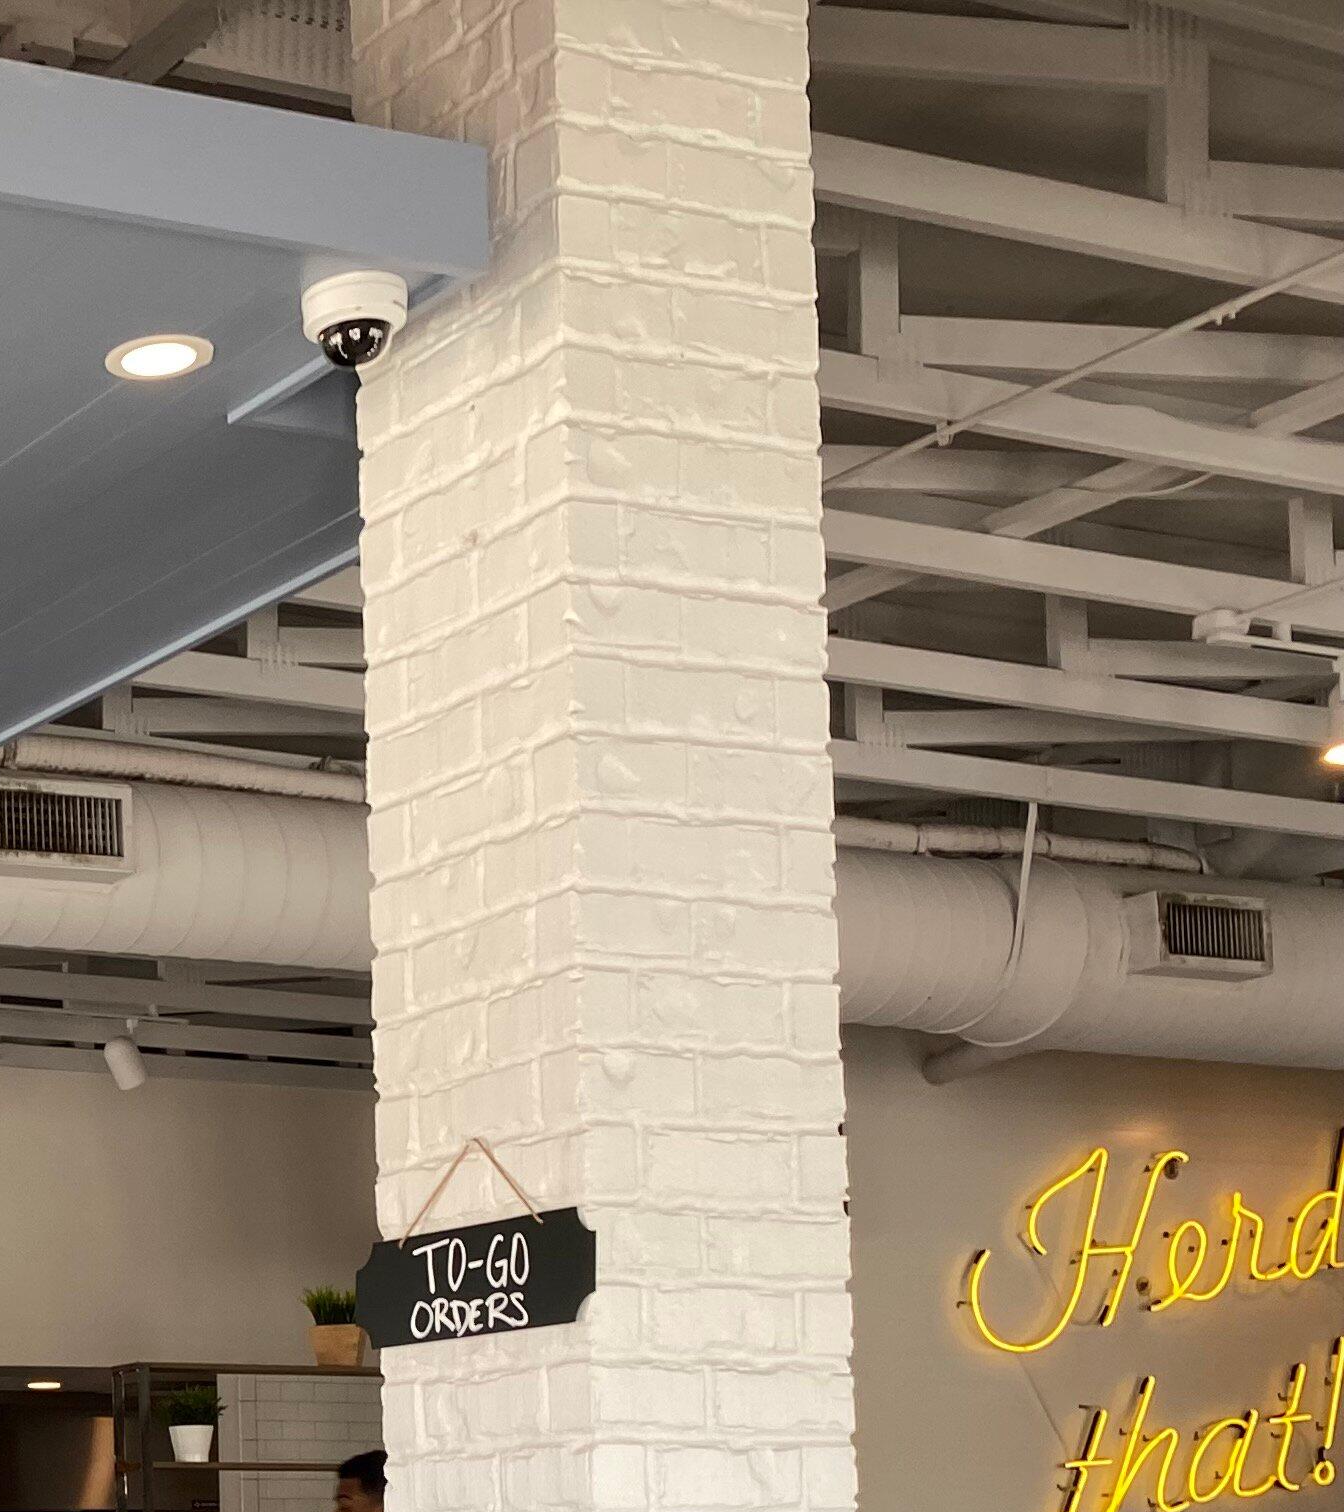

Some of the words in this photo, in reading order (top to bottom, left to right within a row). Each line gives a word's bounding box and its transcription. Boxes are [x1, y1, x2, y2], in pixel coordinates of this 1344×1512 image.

[412, 1231, 530, 1294] TO-GO
[971, 1147, 1344, 1353] Herd
[410, 1291, 529, 1339] ORDERS
